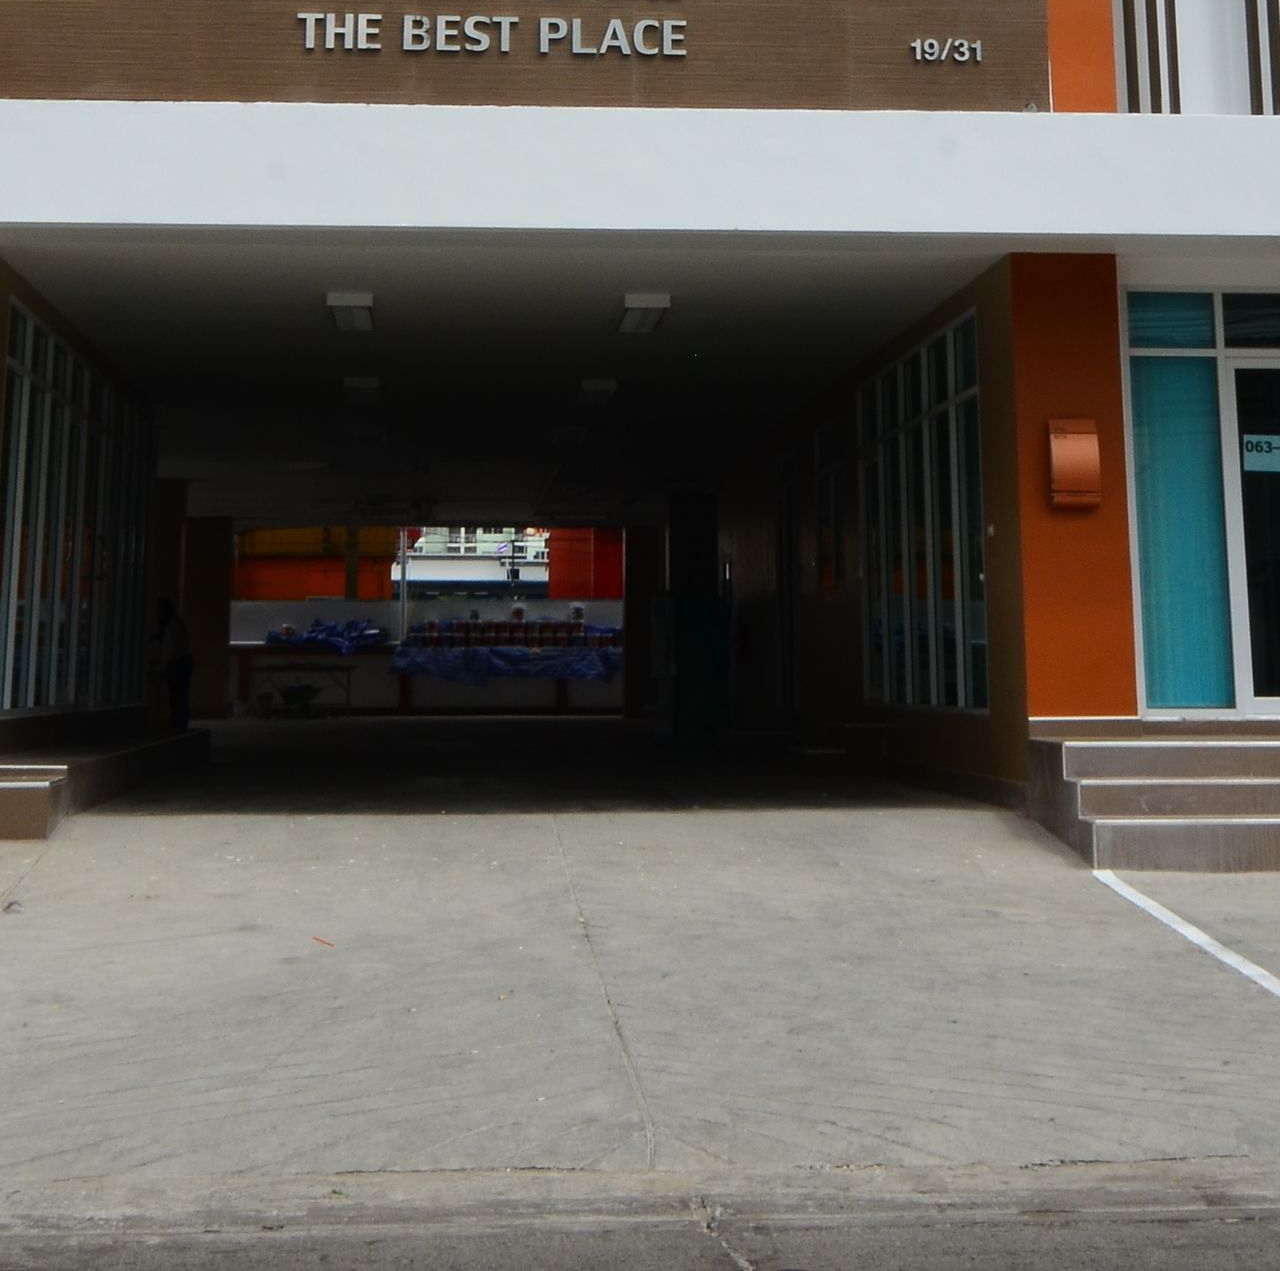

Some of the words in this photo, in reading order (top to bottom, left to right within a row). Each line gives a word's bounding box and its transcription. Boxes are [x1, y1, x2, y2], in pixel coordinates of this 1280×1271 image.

[297, 12, 383, 49] THE
[403, 14, 520, 52] BEST
[540, 18, 688, 56] PLACE
[910, 38, 983, 62] 19/31
